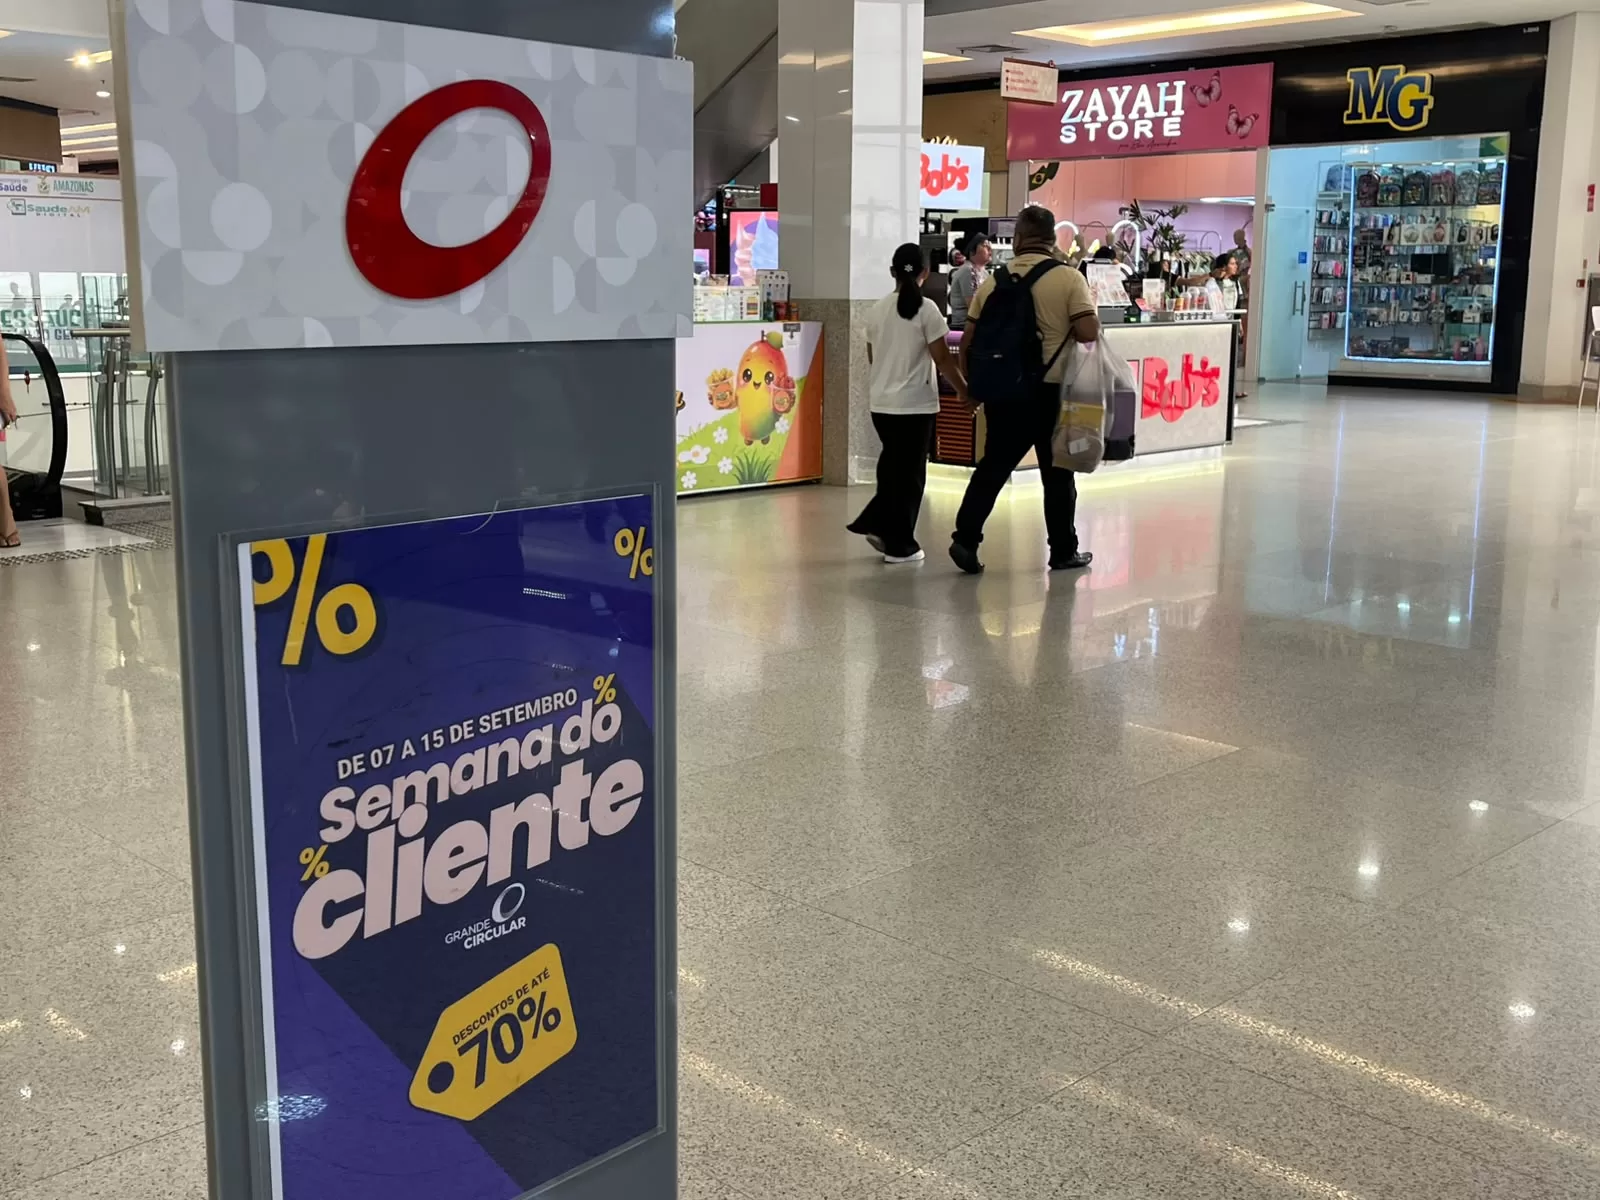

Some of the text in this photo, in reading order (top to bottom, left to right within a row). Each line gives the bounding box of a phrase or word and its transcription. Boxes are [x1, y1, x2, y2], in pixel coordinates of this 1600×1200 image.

[1060, 80, 1186, 124] ZAYAH
[1343, 64, 1434, 131] MG
[1060, 117, 1182, 144] STORE
[53, 180, 94, 193] AMAZONAS
[337, 688, 578, 780] DE 07 A 15 DE SETEMBRO
[560, 698, 622, 755] do
[293, 758, 645, 960] cliente
[444, 917, 491, 945] GRANDE
[463, 916, 527, 949] CIRCULAR
[452, 966, 551, 1046] DESCONTOS DE ATÉ
[457, 990, 562, 1088] 70%
